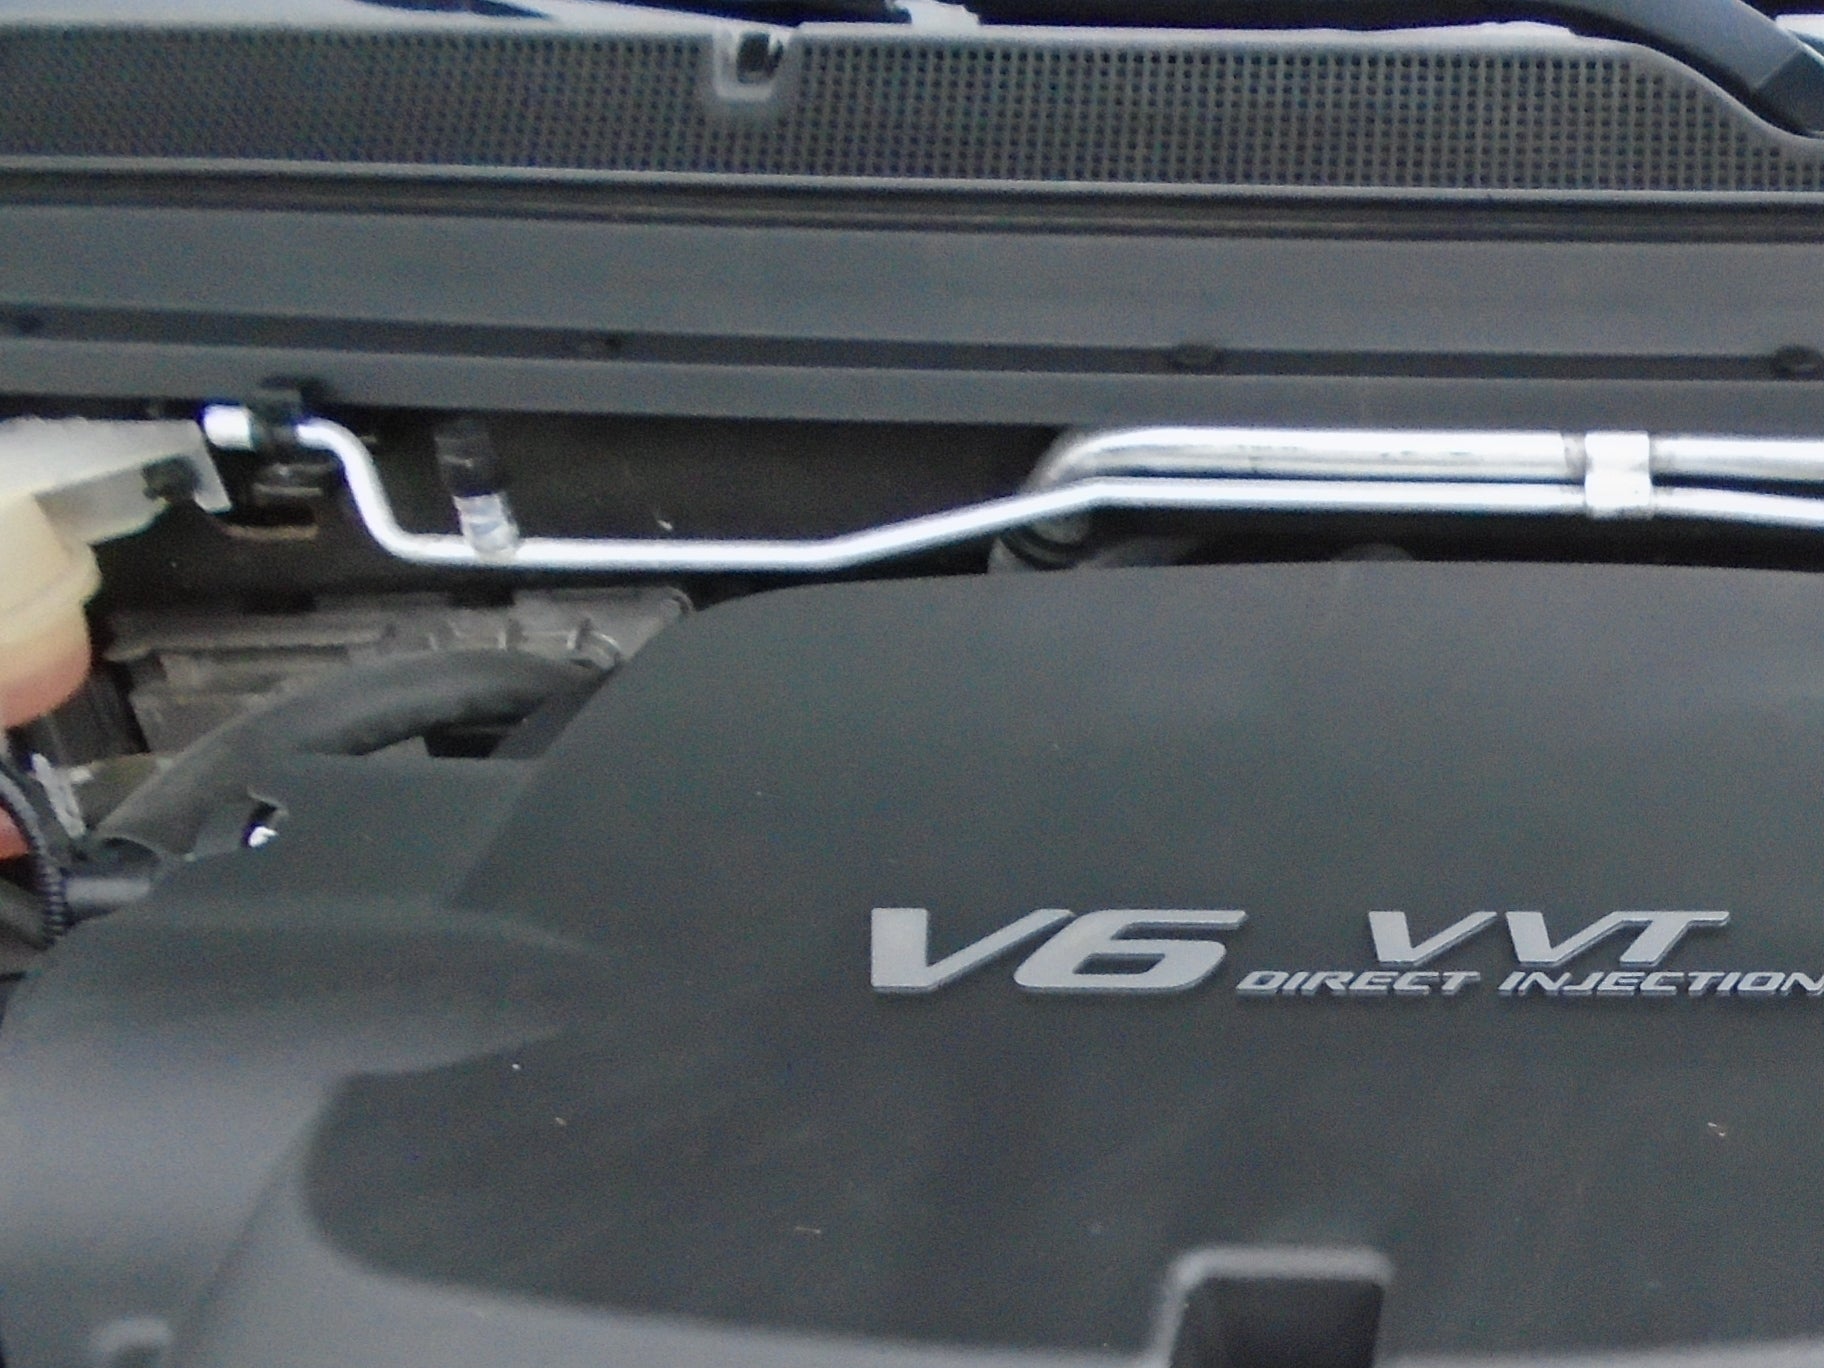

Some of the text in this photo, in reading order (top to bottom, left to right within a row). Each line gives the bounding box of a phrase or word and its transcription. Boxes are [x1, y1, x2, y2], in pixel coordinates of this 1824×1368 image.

[869, 906, 1732, 995] V6 VVT
[1235, 968, 1483, 997] DIRECT
